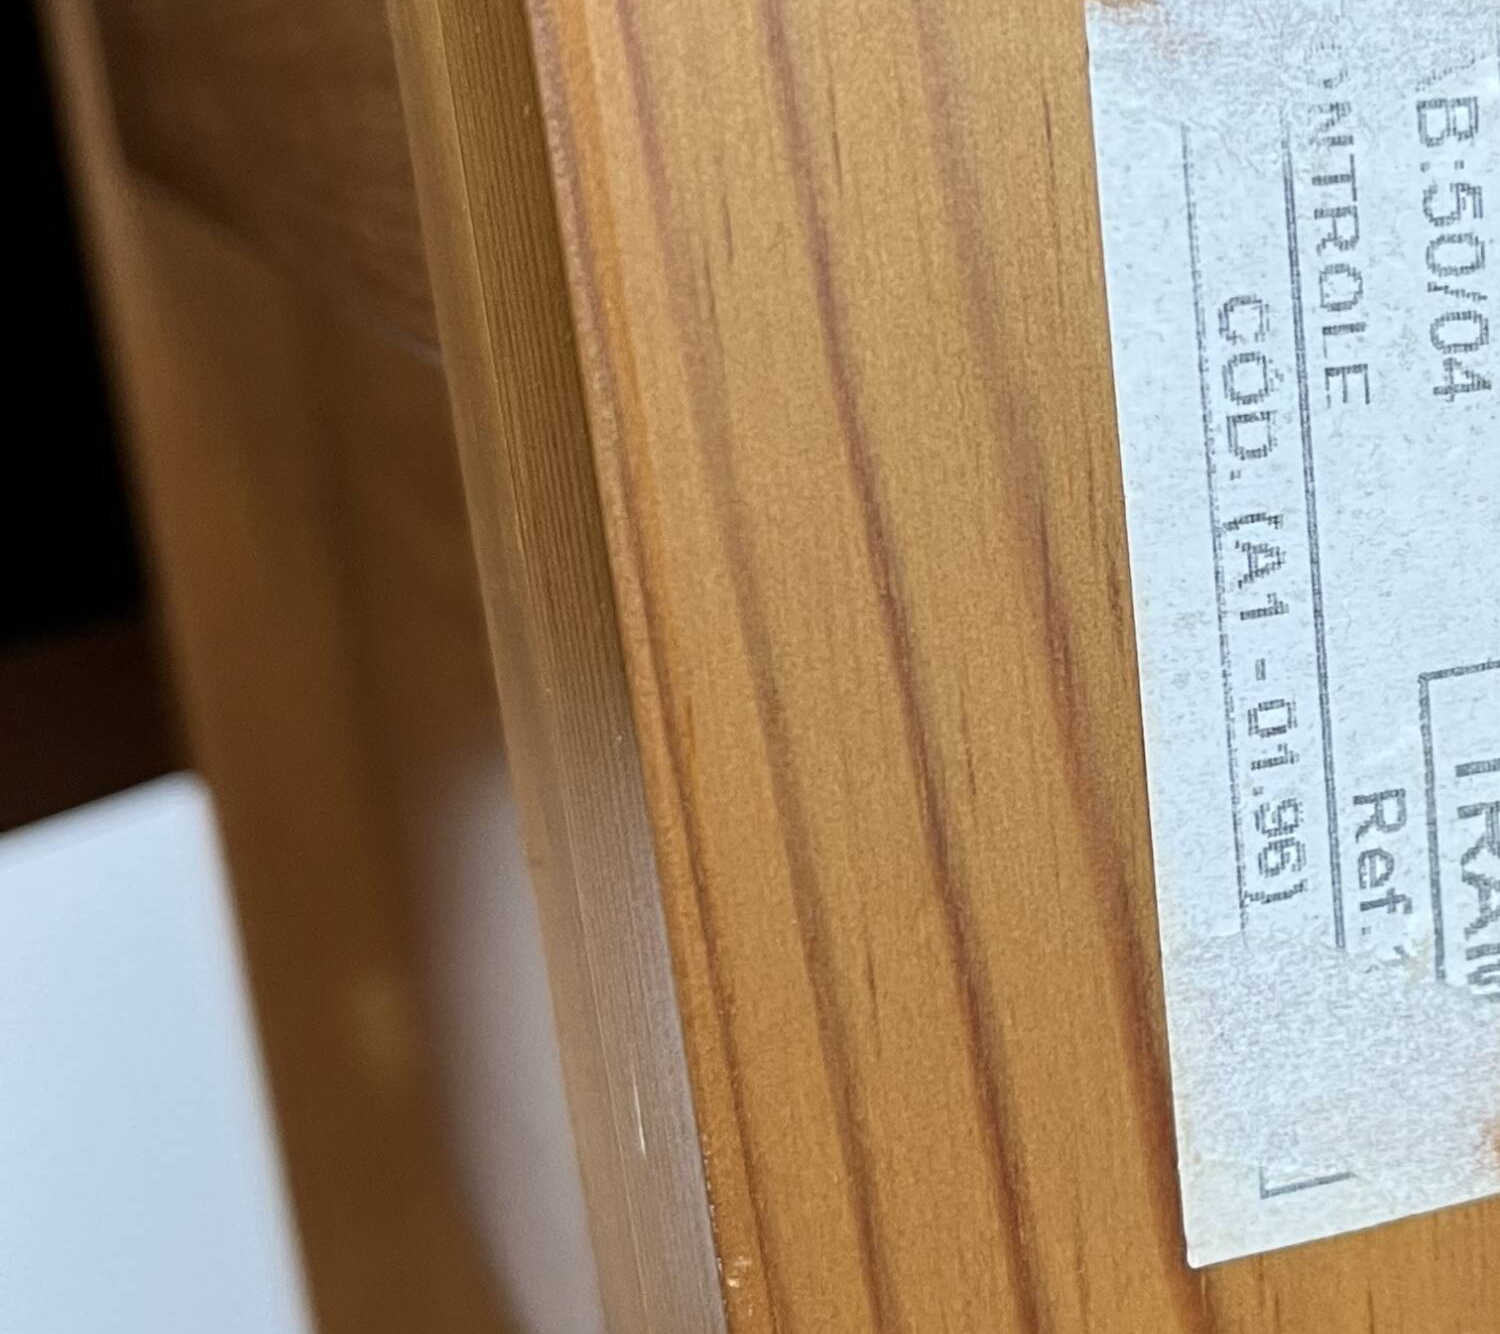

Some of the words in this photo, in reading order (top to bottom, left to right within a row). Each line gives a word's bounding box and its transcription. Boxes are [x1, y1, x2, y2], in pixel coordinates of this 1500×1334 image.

[1217, 294, 1284, 482] CÓD.
[1222, 512, 1290, 621] (A1
[1242, 697, 1309, 906] 01.96)
